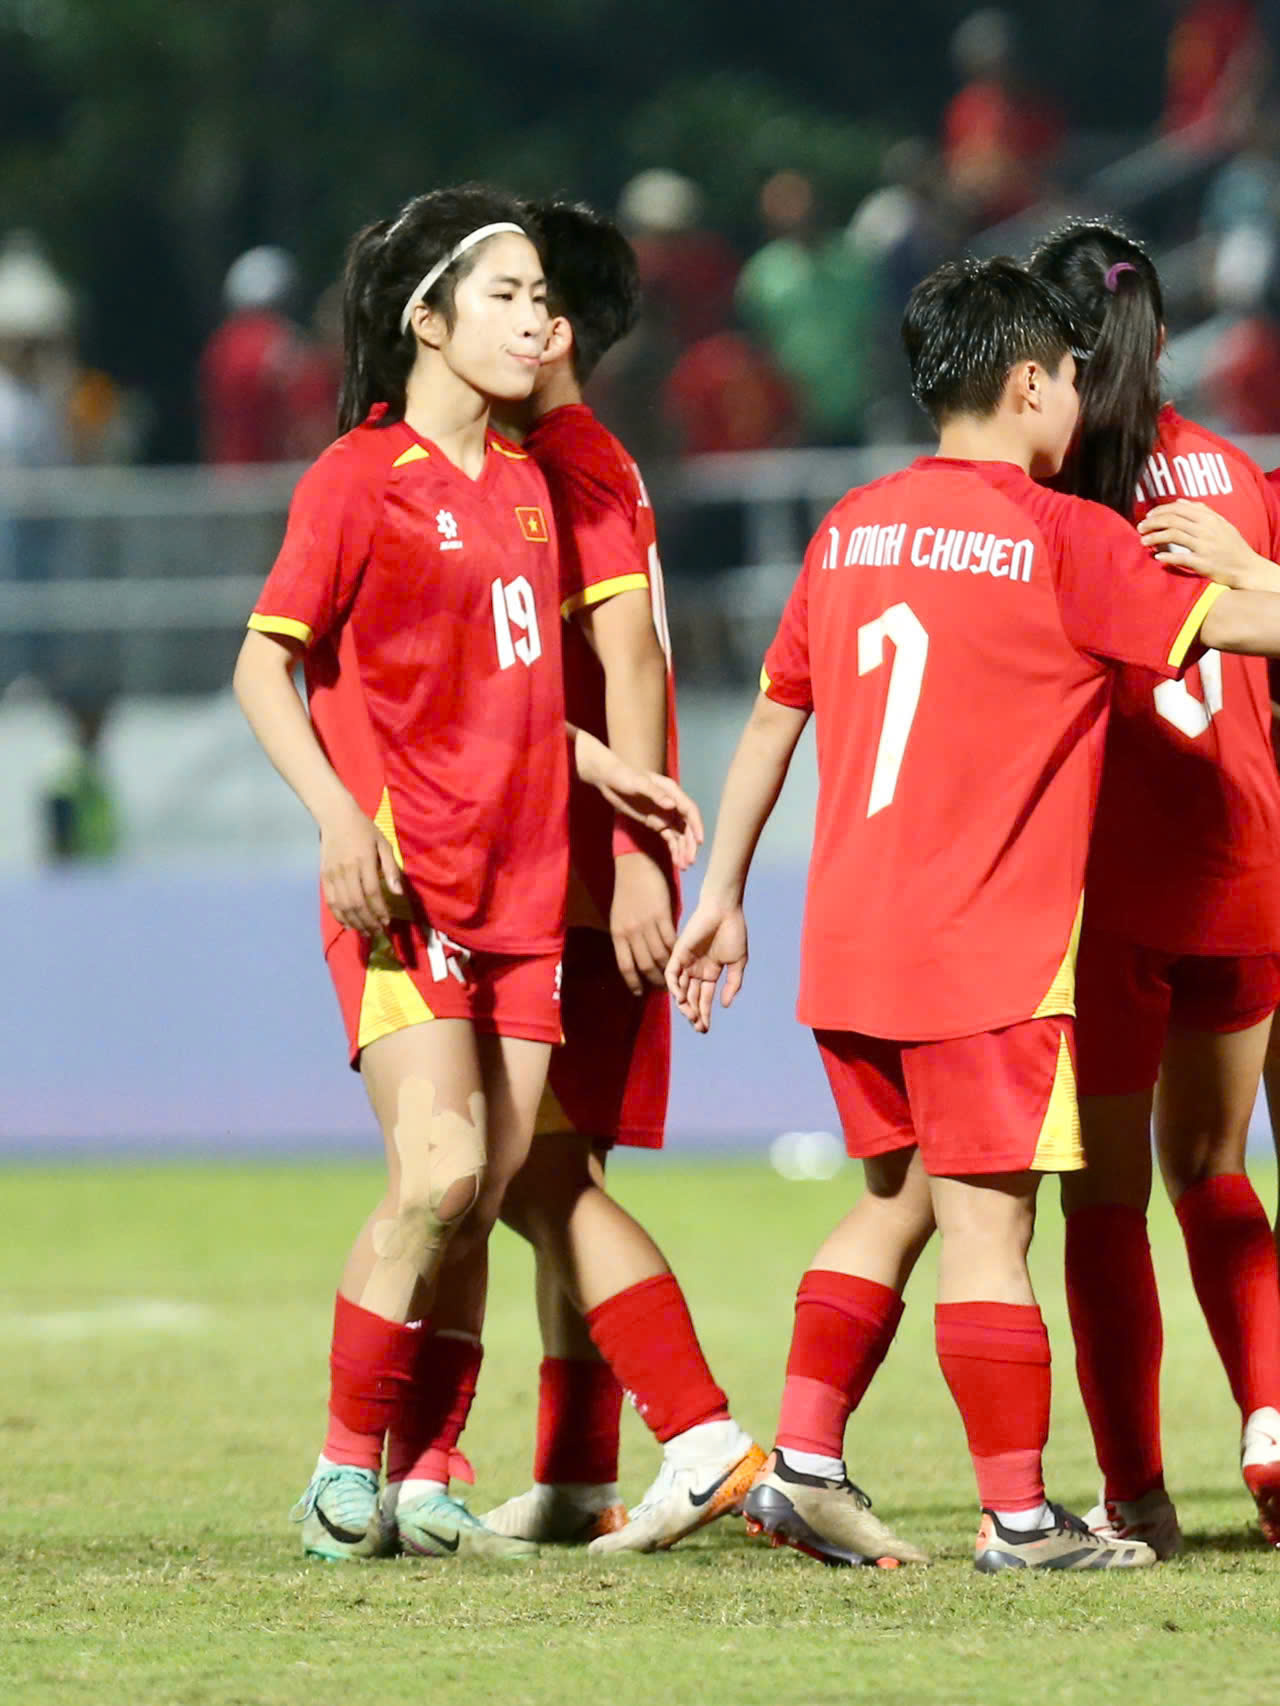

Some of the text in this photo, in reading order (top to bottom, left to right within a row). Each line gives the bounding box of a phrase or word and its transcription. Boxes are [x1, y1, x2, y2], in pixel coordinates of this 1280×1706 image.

[911, 526, 1034, 582] CHUYEN
[491, 575, 543, 671] 19
[857, 601, 930, 819] 7
